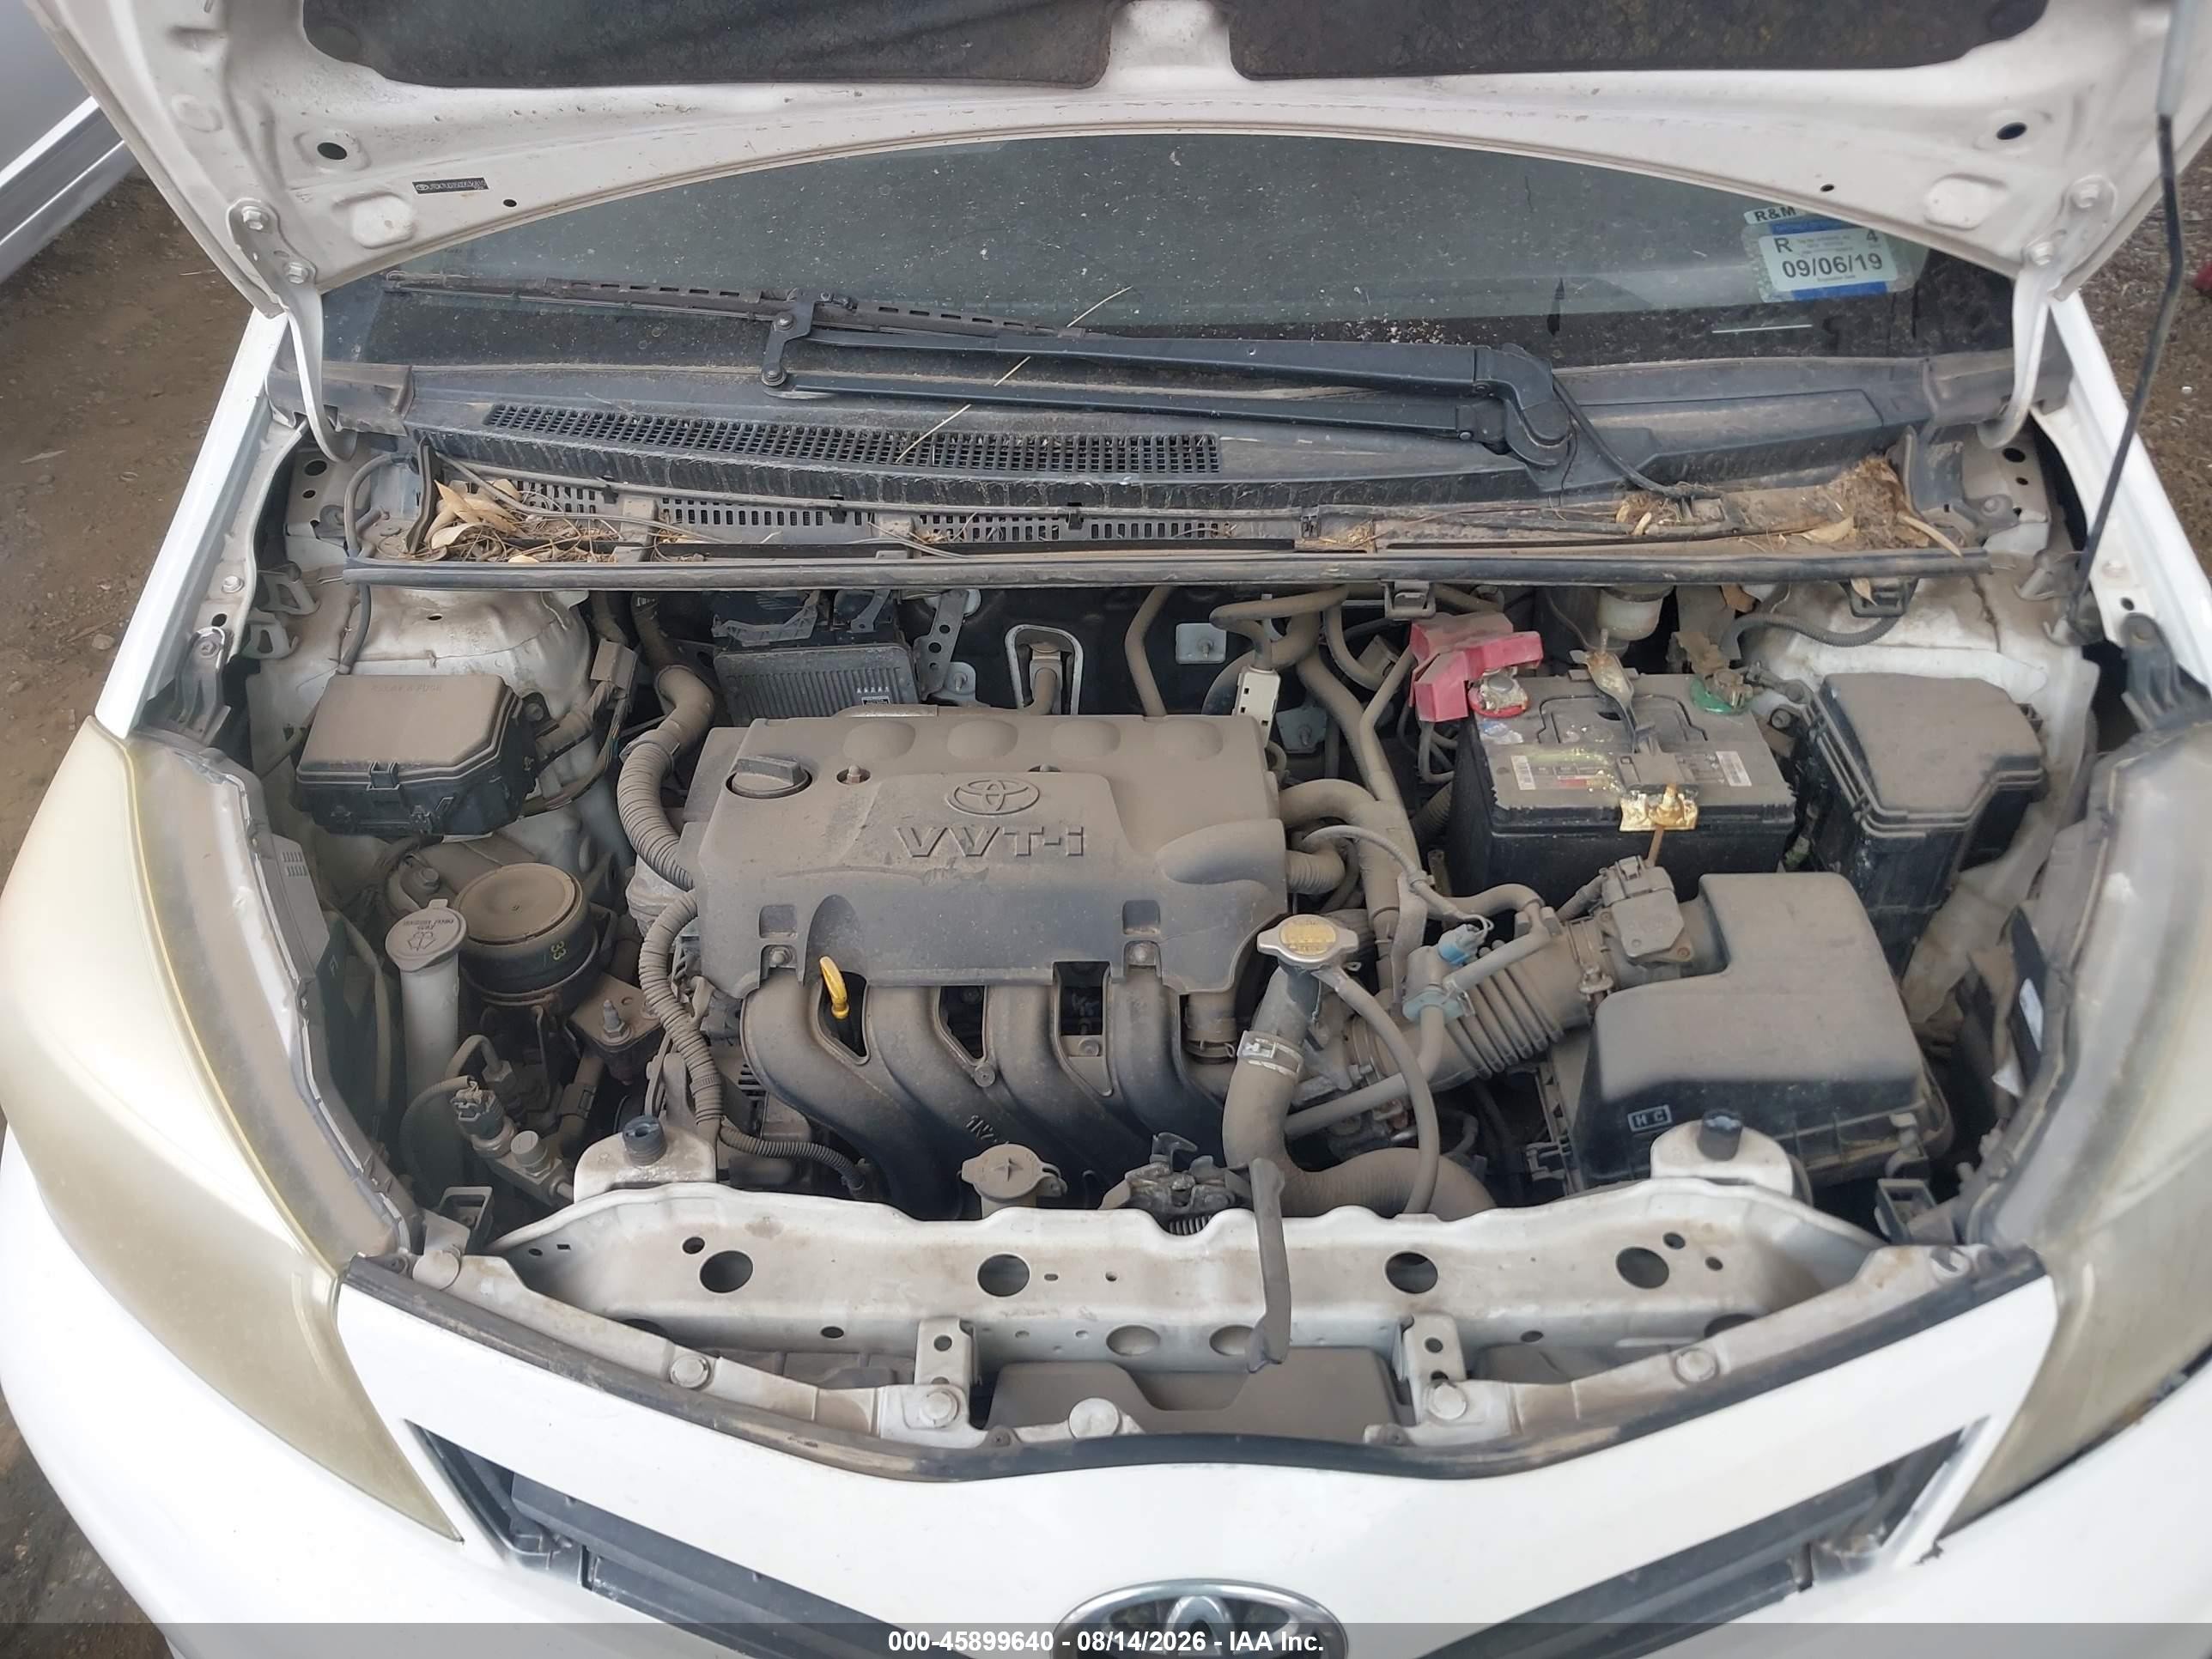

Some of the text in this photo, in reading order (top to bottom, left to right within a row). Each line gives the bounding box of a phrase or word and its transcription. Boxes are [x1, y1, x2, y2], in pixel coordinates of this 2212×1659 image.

[1773, 237, 1793, 253] R
[1866, 228, 1878, 242] 4
[1782, 252, 1883, 278] 09/06/19
[893, 825, 1085, 858] VVT-i
